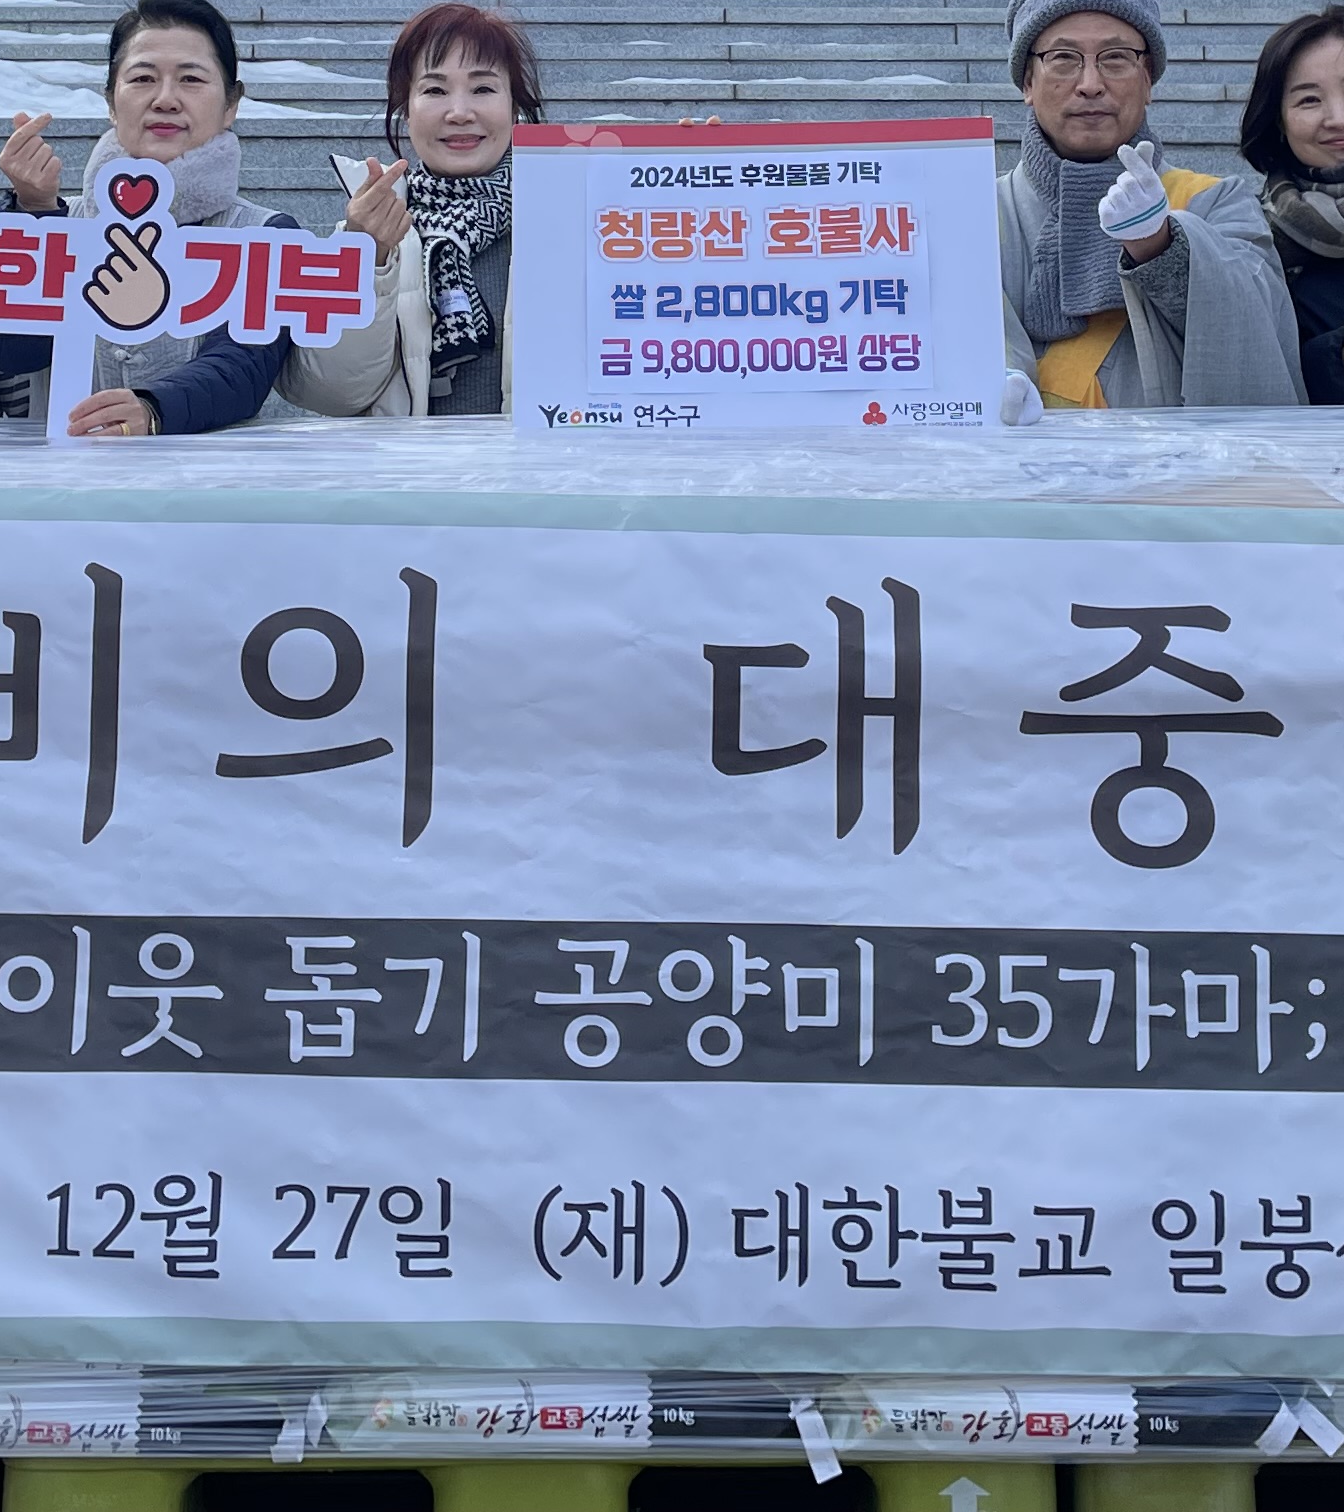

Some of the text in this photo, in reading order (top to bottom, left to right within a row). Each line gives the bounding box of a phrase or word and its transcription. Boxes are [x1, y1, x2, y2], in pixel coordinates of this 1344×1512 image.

[630, 161, 882, 188] 2024년도 후원물품 기탁
[598, 204, 916, 260] 청량산 호불사
[180, 241, 361, 334] 기부
[610, 279, 909, 323] 쌀 2,800kg 기탁
[599, 333, 922, 379] 금 9,800,000원 상당
[538, 404, 701, 428] Yeonsu 연수구
[891, 402, 982, 421] 사랑의열매
[264, 930, 481, 1063] 돕기
[534, 937, 875, 1069] 공양미
[930, 944, 1326, 1074] 35가마;
[46, 1172, 223, 1278] 12월
[272, 1178, 453, 1278] 27일
[533, 1180, 689, 1288] (재)
[731, 1182, 1112, 1292] 대한불교
[476, 1378, 540, 1439] 강화
[540, 1406, 583, 1430] 교동
[584, 1406, 641, 1438] 섬쌀
[662, 1407, 695, 1426] 10kg
[963, 1385, 1026, 1442] 강화
[1026, 1413, 1069, 1436] 교동
[1069, 1413, 1127, 1445] 섬쌀
[1149, 1416, 1179, 1433] 10kg
